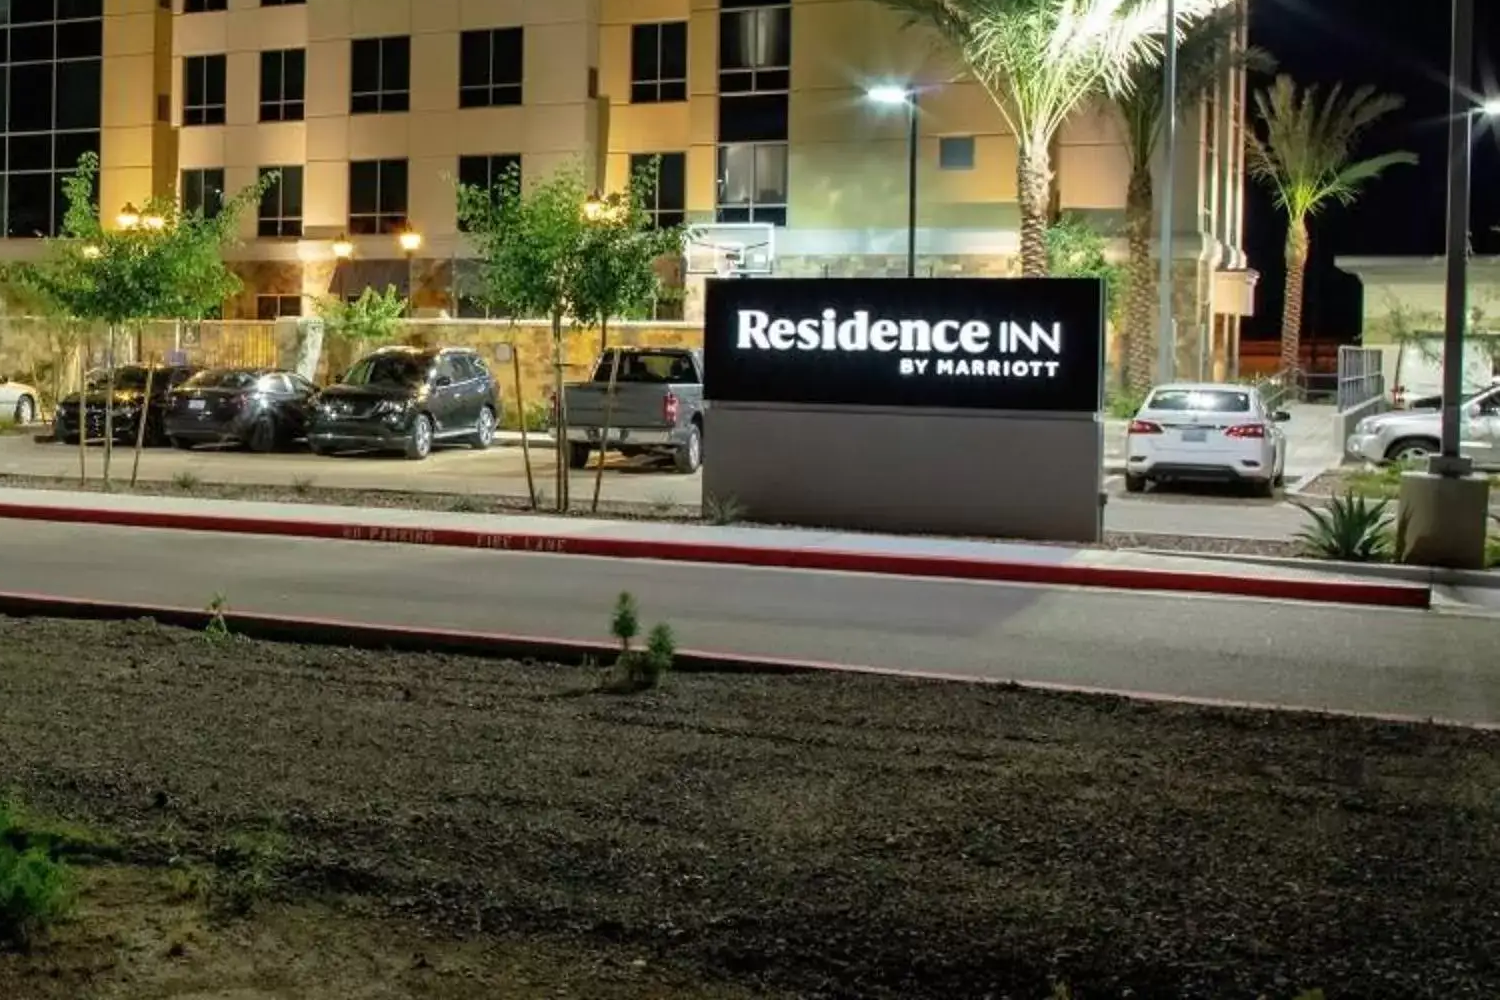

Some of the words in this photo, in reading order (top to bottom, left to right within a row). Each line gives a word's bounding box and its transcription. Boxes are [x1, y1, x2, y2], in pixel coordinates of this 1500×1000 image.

[737, 308, 991, 352] Residence
[999, 321, 1061, 354] INN
[899, 358, 929, 376] BY
[936, 359, 1060, 378] MARRIOTT
